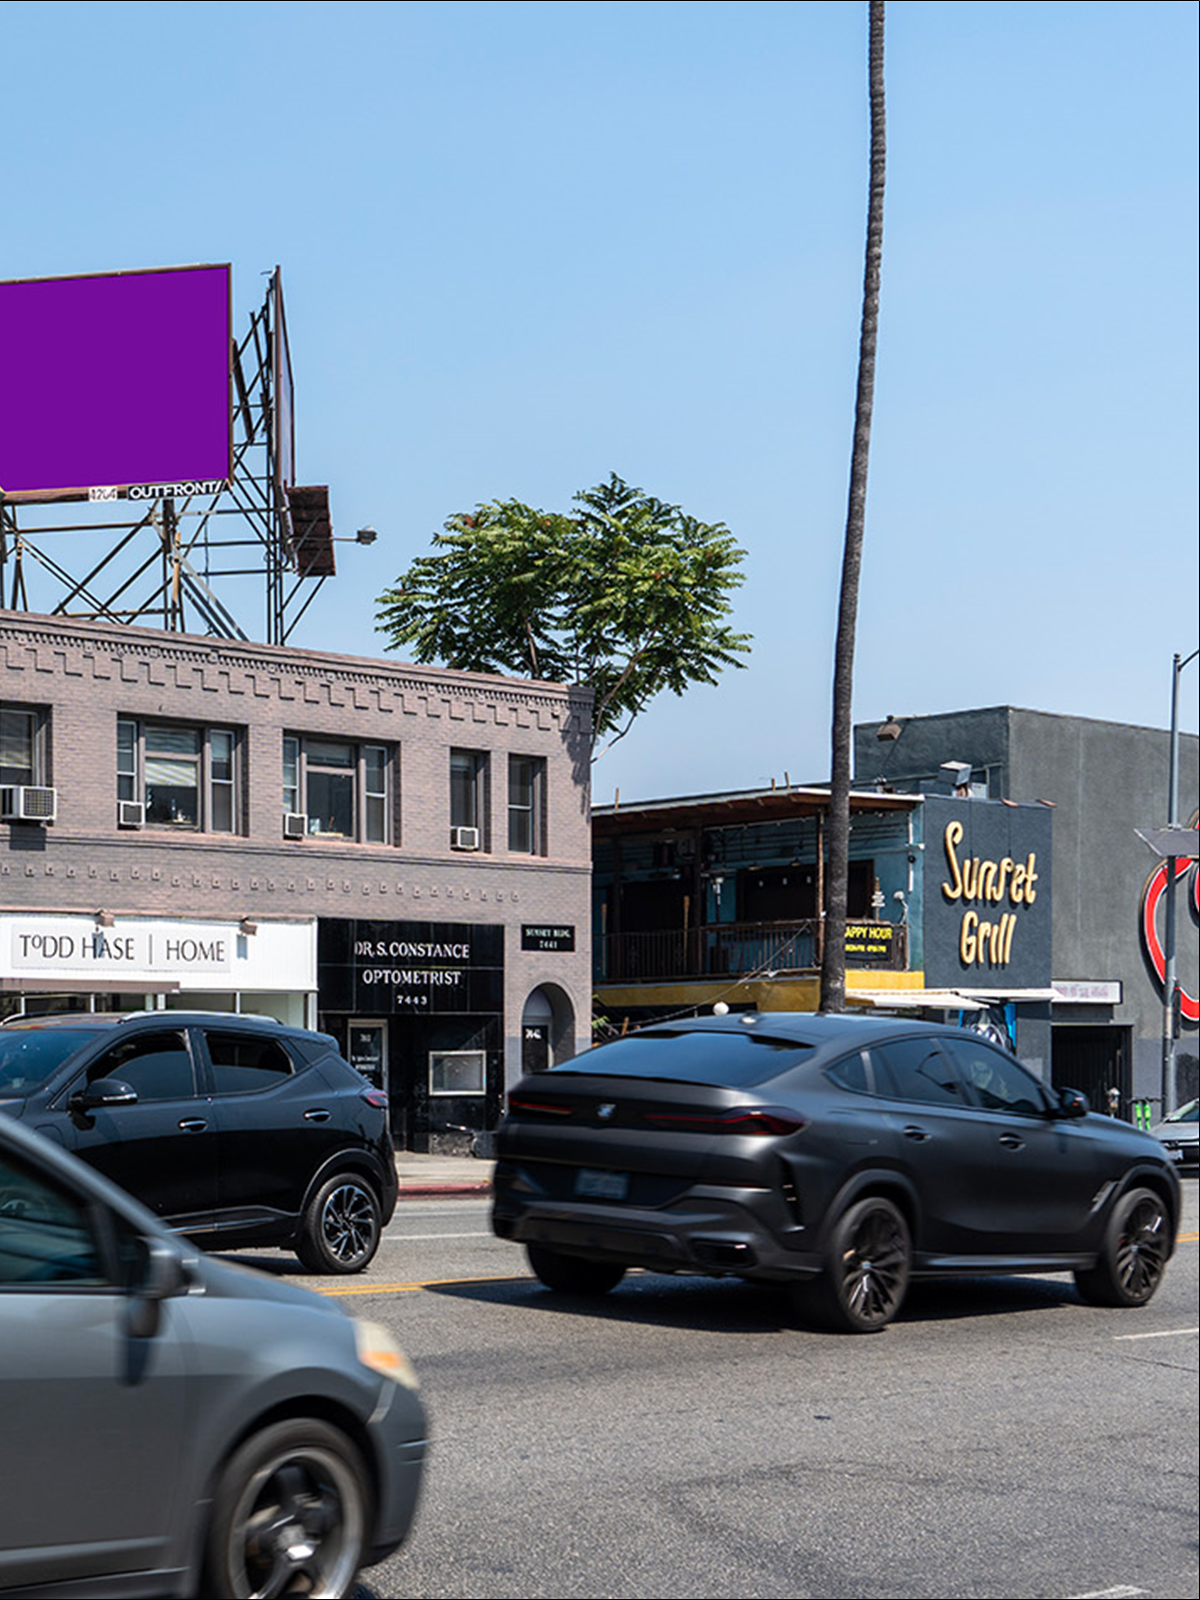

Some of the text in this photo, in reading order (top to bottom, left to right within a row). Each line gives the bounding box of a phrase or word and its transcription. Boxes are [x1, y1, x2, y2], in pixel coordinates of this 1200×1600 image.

[942, 820, 1039, 905] Sunset
[844, 926, 892, 939] APPY HOUR
[960, 910, 1017, 965] Grill
[81, 936, 135, 960] HASE
[166, 939, 225, 962] HOME
[389, 941, 470, 959] CONSTANCE
[362, 969, 462, 986] OPTOMETRIST
[396, 995, 428, 1006] 7443
